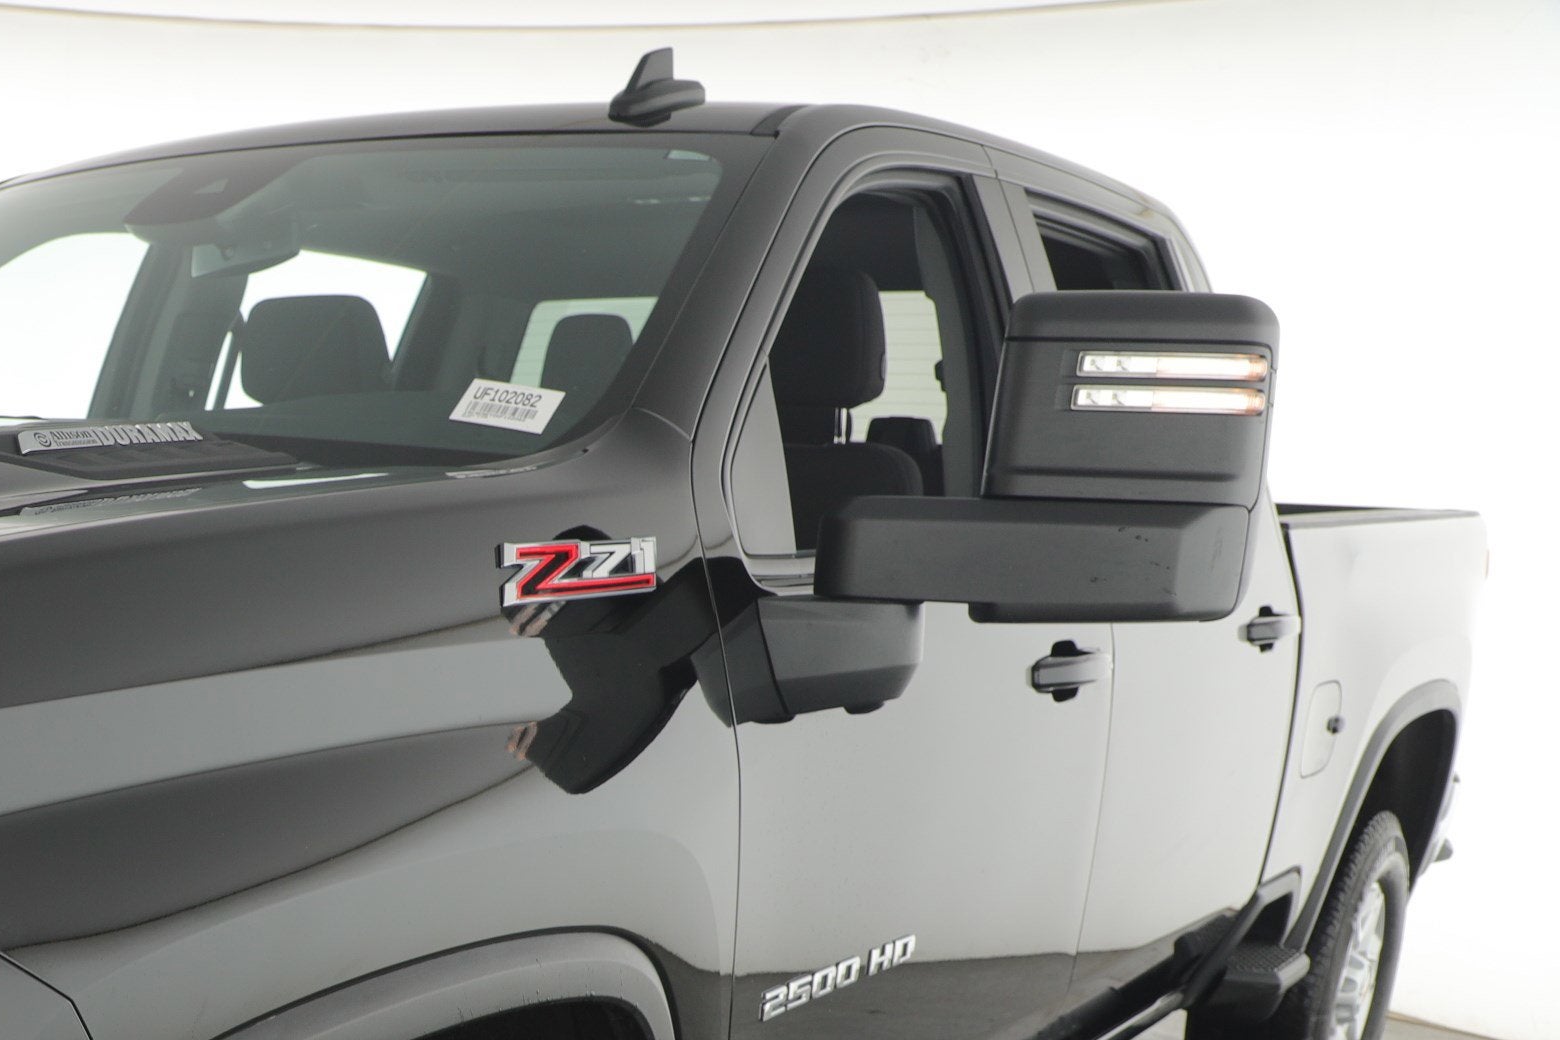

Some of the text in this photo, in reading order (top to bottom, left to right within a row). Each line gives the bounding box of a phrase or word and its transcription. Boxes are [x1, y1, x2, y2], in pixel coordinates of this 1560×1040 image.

[473, 386, 542, 408] UF102082
[93, 421, 203, 446] DURAMAX
[494, 536, 657, 608] Z71
[759, 933, 916, 1022] 2500 HD
